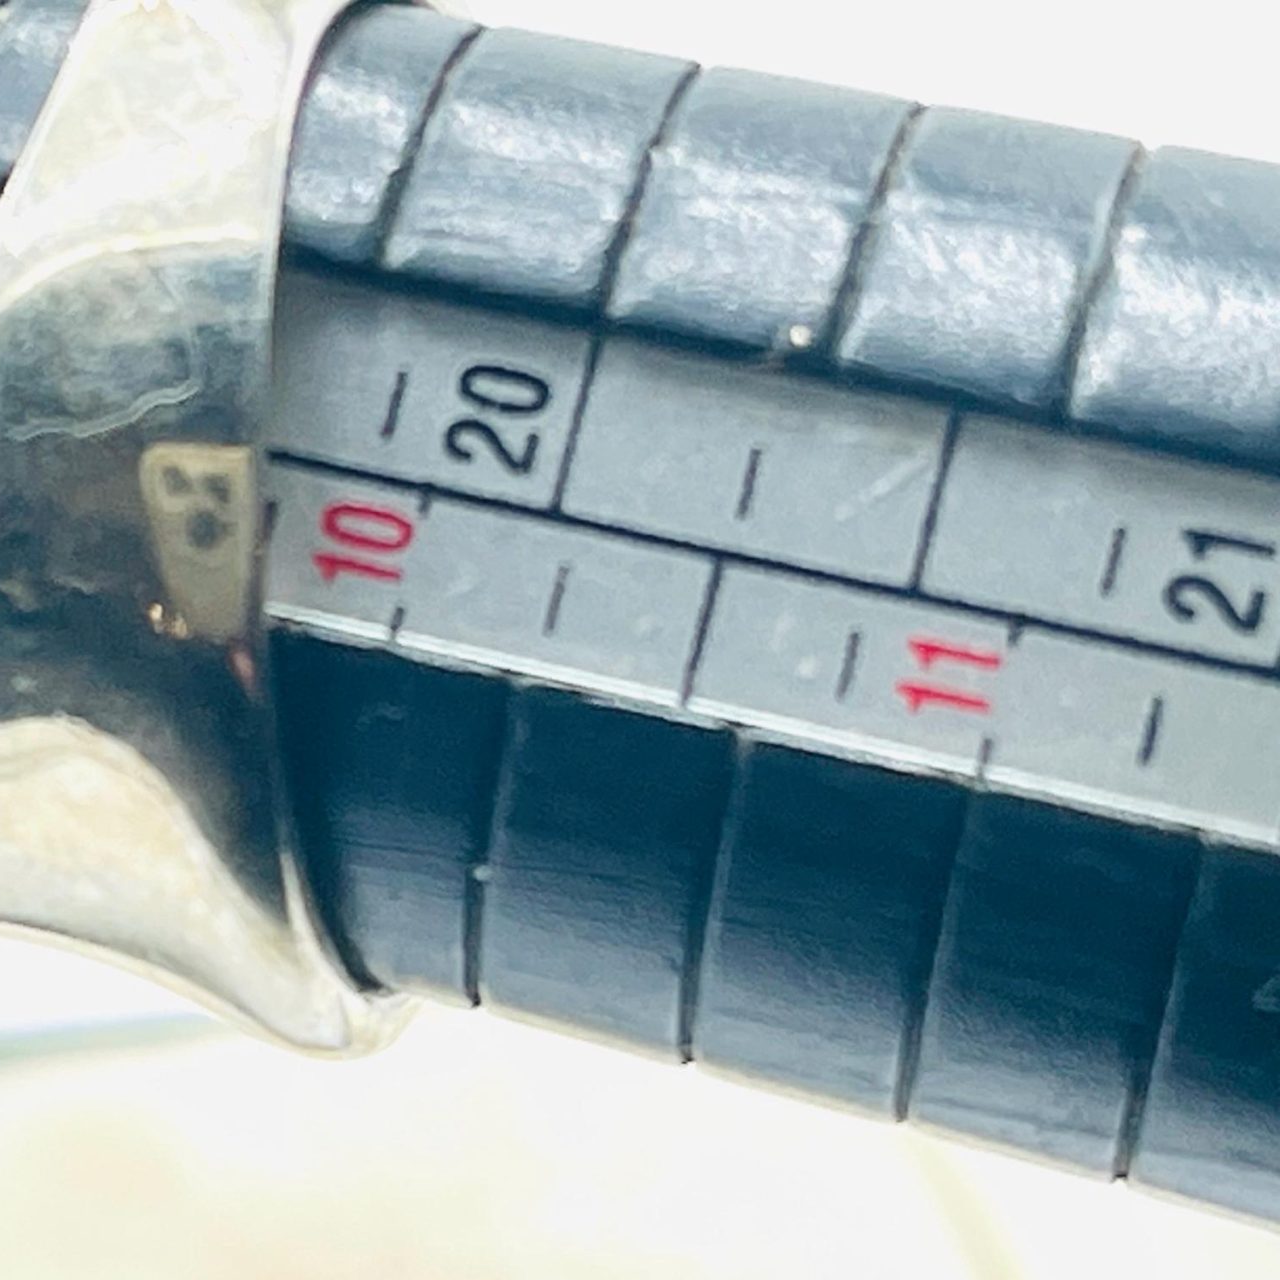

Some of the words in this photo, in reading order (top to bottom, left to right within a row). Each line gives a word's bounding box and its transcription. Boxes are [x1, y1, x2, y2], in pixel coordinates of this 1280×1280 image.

[444, 365, 551, 473] 20
[313, 503, 413, 584] 10
[1163, 528, 1276, 636] 21
[896, 636, 1002, 713] 11
